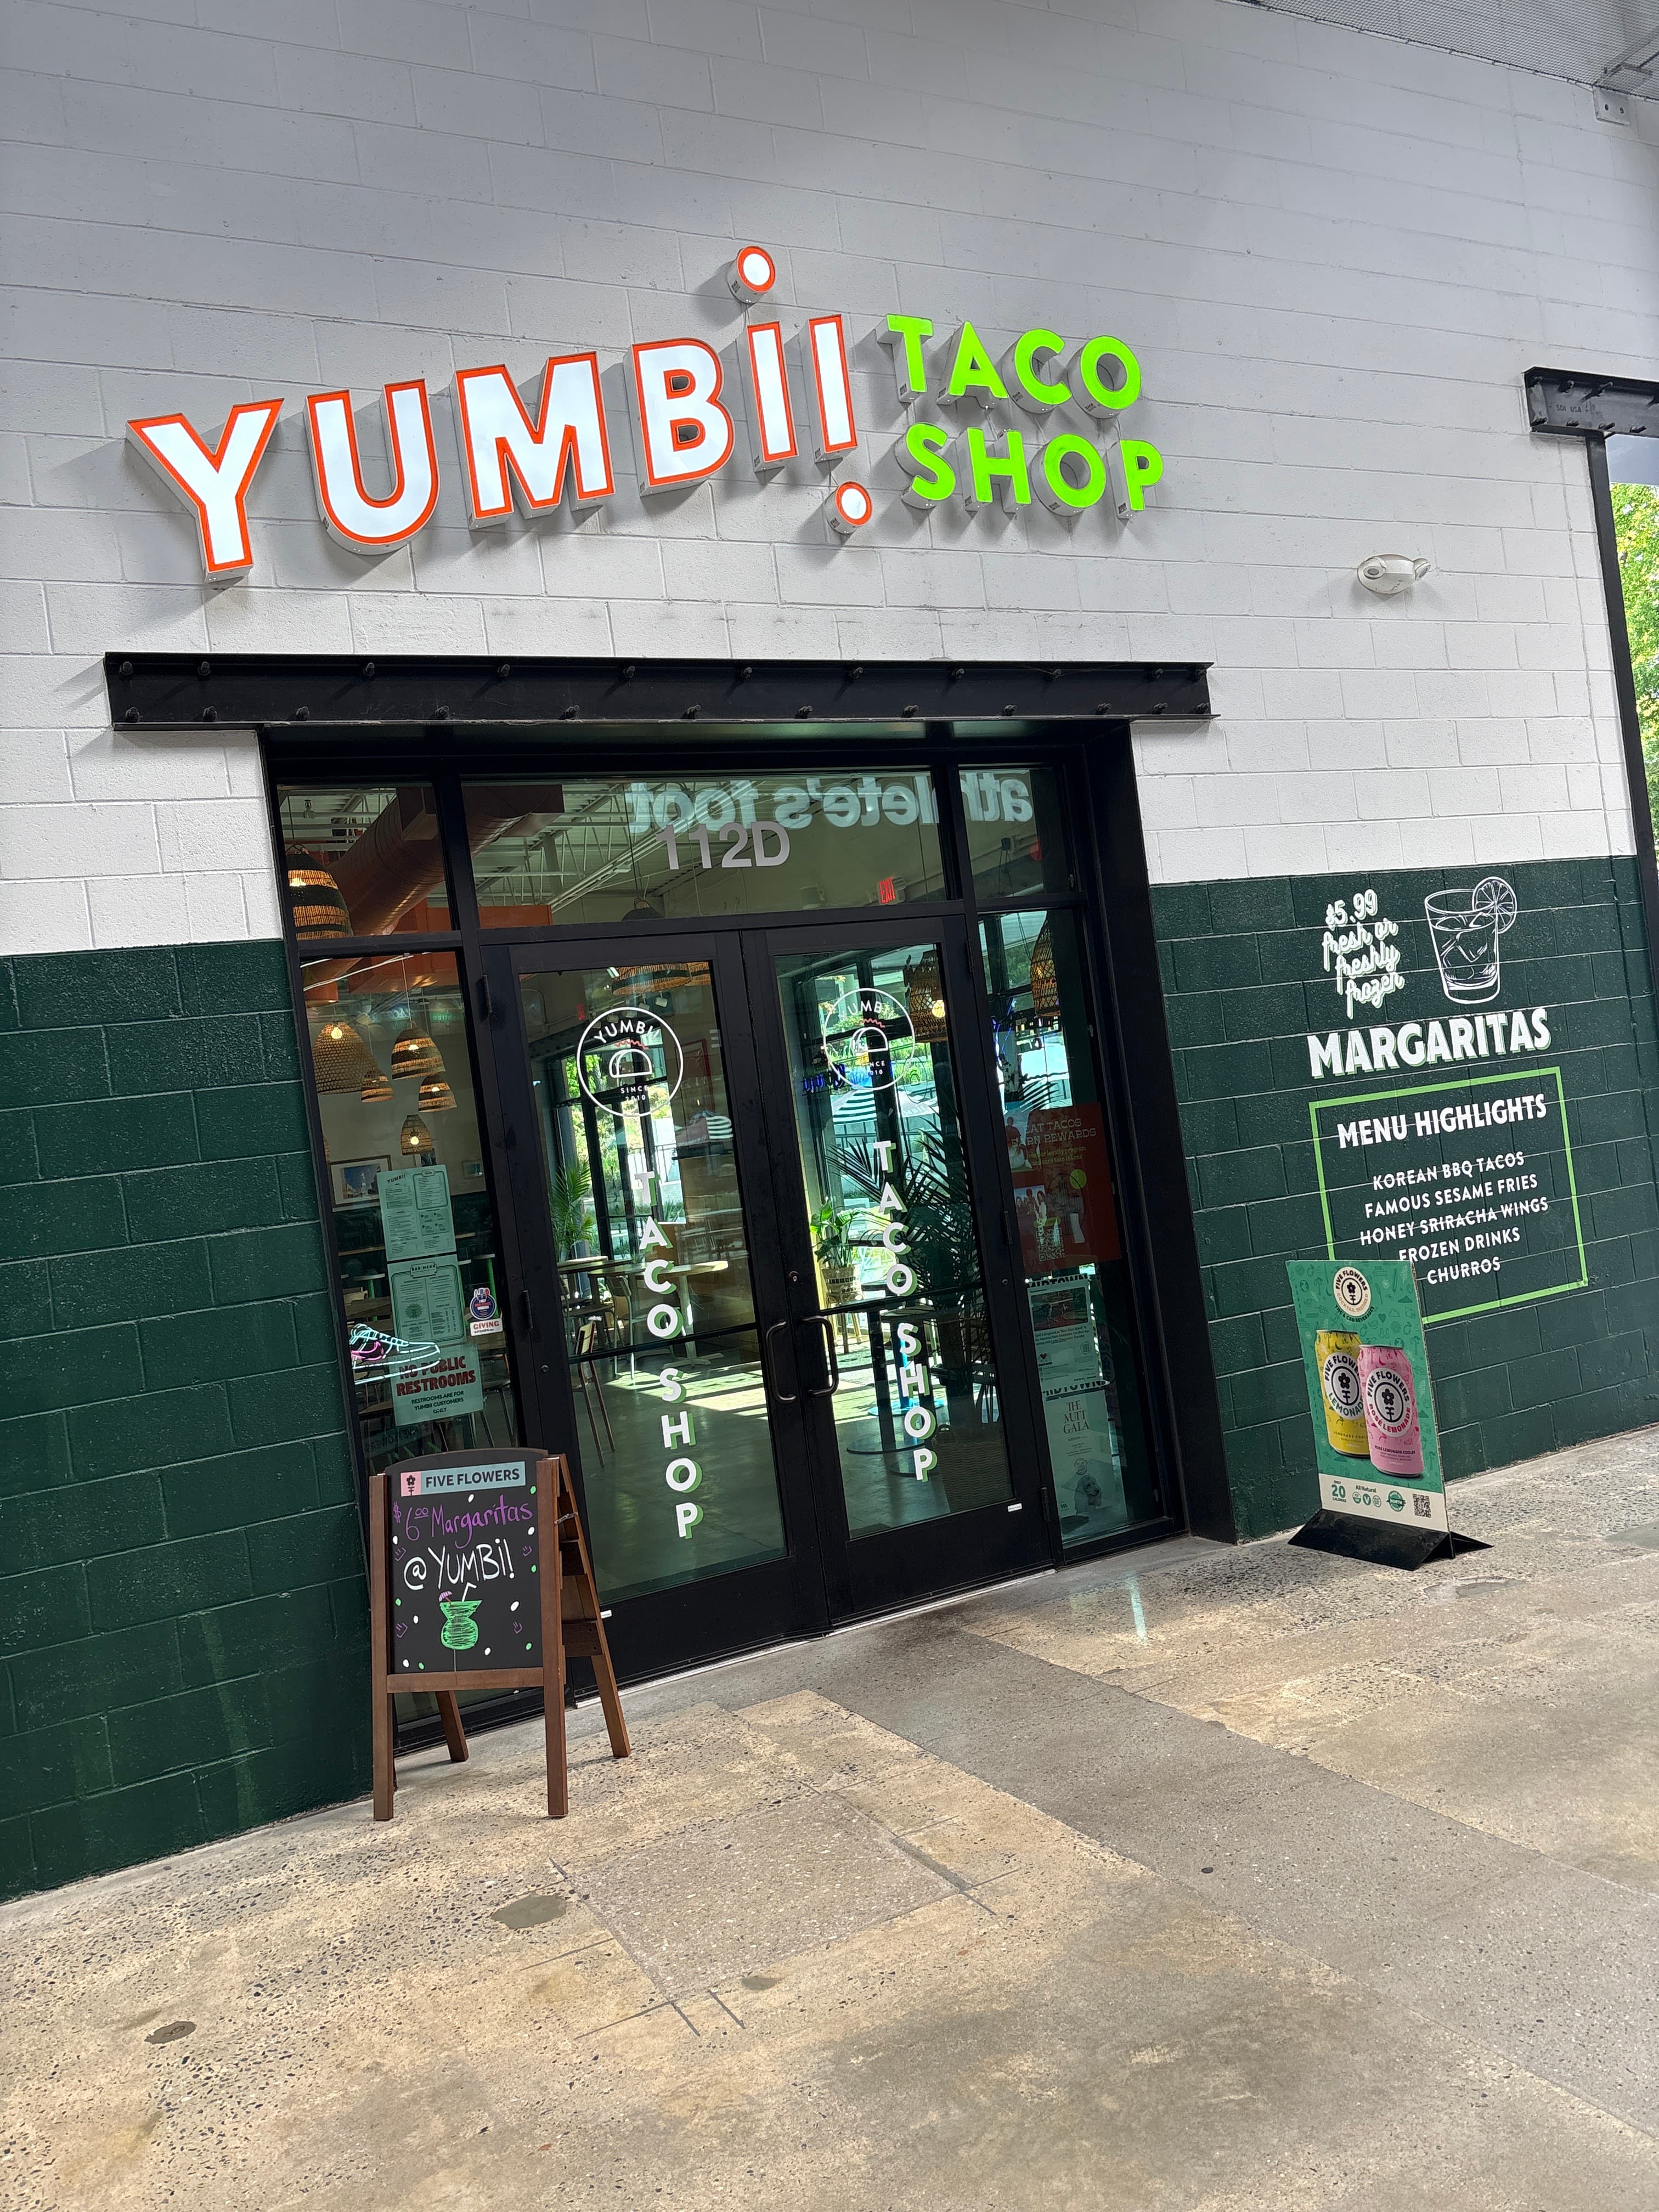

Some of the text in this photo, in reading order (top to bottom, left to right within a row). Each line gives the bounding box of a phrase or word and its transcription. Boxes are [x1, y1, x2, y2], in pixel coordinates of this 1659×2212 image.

[881, 313, 1142, 413] TACO
[902, 422, 1164, 514] SHOP
[655, 821, 791, 871] 112D
[879, 878, 896, 904] EXIT
[1324, 889, 1378, 931] $5.99
[1323, 917, 1399, 972] fresh or
[1335, 944, 1401, 995] freshly
[1346, 972, 1405, 1019] frozen
[1307, 1008, 1551, 1079] MARGARITAS
[620, 1085, 649, 1094] SINCE
[1024, 1118, 1082, 1134] EAT TACOS
[1337, 1093, 1547, 1149] MENU HIGHLIGHTS
[1011, 1128, 1097, 1147] EARN REWARDS
[1047, 1148, 1064, 1157] loyalty
[1064, 1146, 1086, 1155] program
[1373, 1150, 1525, 1190] KOREAN BBQ TACOS
[1364, 1173, 1538, 1218] FAMOUS SESAME FRIES
[873, 1141, 917, 1297] TACO
[1359, 1197, 1549, 1246] HONEY SRIRACHA WINGS
[634, 1171, 683, 1339] TACO
[1398, 1227, 1521, 1262] FROZEN DRINKS
[1335, 1270, 1368, 1291] FIVE FLOWERS
[1427, 1256, 1501, 1285] CHURROS
[1337, 1293, 1356, 1313] COCKTAIL
[1355, 1306, 1374, 1323] BEVERAGES
[473, 1321, 500, 1330] GIVING
[399, 1355, 466, 1380] NO PUBLIC
[1325, 1355, 1359, 1381] FIVE FLOWE
[396, 1370, 476, 1396] RESTROOMS
[1367, 1370, 1410, 1402] FIVE FLOWERS
[411, 1394, 443, 1405] RESTROOMS
[433, 1397, 464, 1408] CUSTOMERS
[898, 1322, 938, 1482] SHOP
[1066, 1400, 1082, 1412] THE
[1328, 1392, 1363, 1417] LEMONAD
[1063, 1421, 1090, 1434] GALA
[1064, 1410, 1087, 1424] MUTT
[1369, 1403, 1410, 1433] ROSÉ LEMONADE
[659, 1367, 703, 1539] SHOP
[425, 1468, 521, 1488] FIVE FLOWERS
[1331, 1484, 1346, 1498] 20
[431, 1494, 533, 1549] Margaritas
